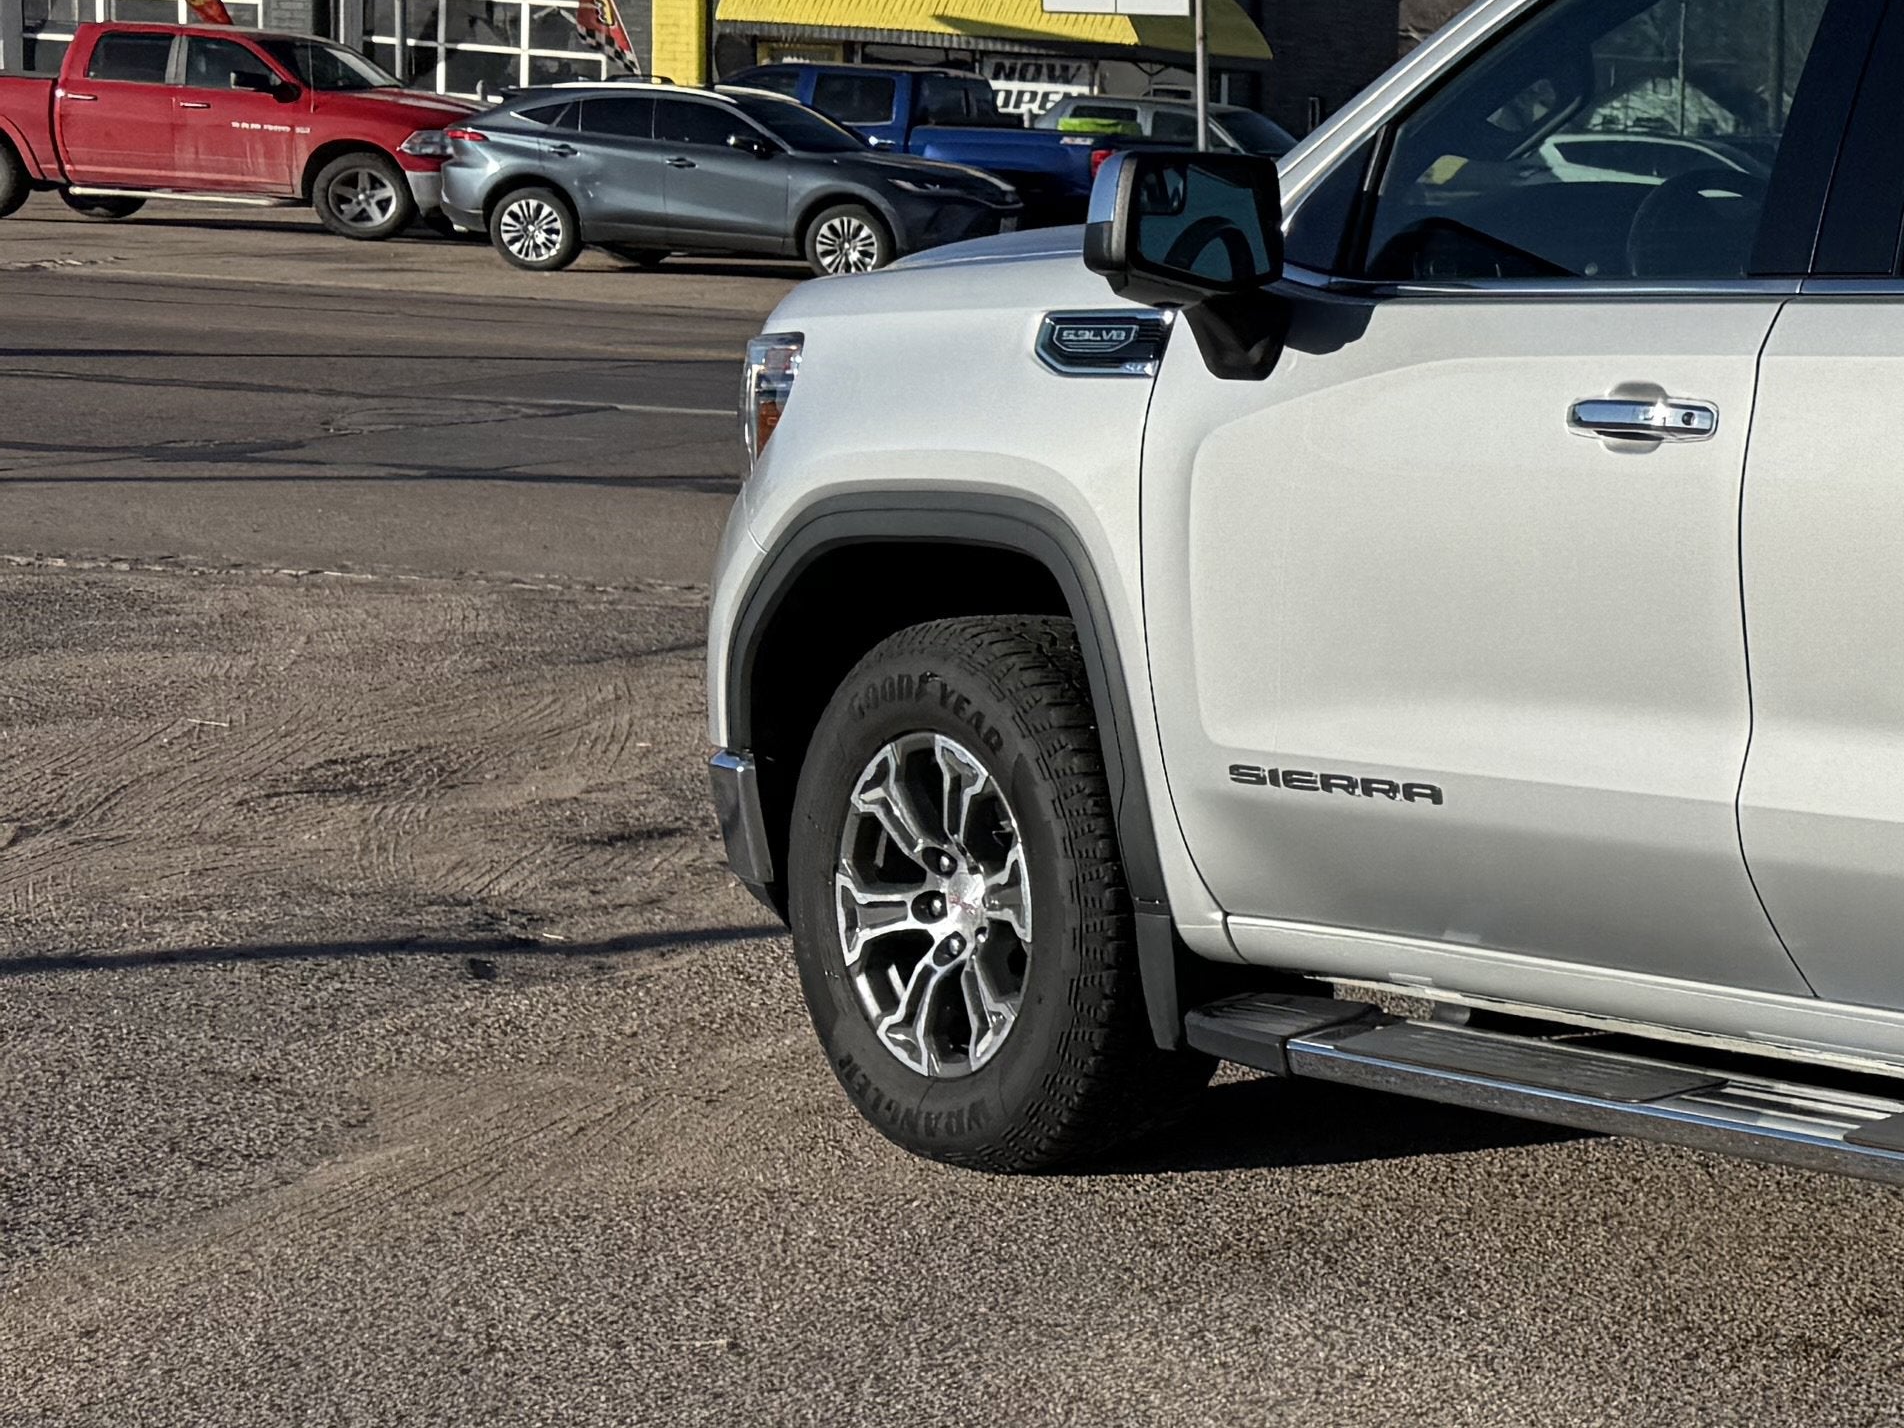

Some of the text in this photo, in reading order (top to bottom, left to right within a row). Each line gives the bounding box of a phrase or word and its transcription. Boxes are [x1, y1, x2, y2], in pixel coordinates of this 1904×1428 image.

[991, 60, 1083, 84] NOW
[993, 88, 1089, 111] OPE
[1228, 763, 1444, 806] SIERRA
